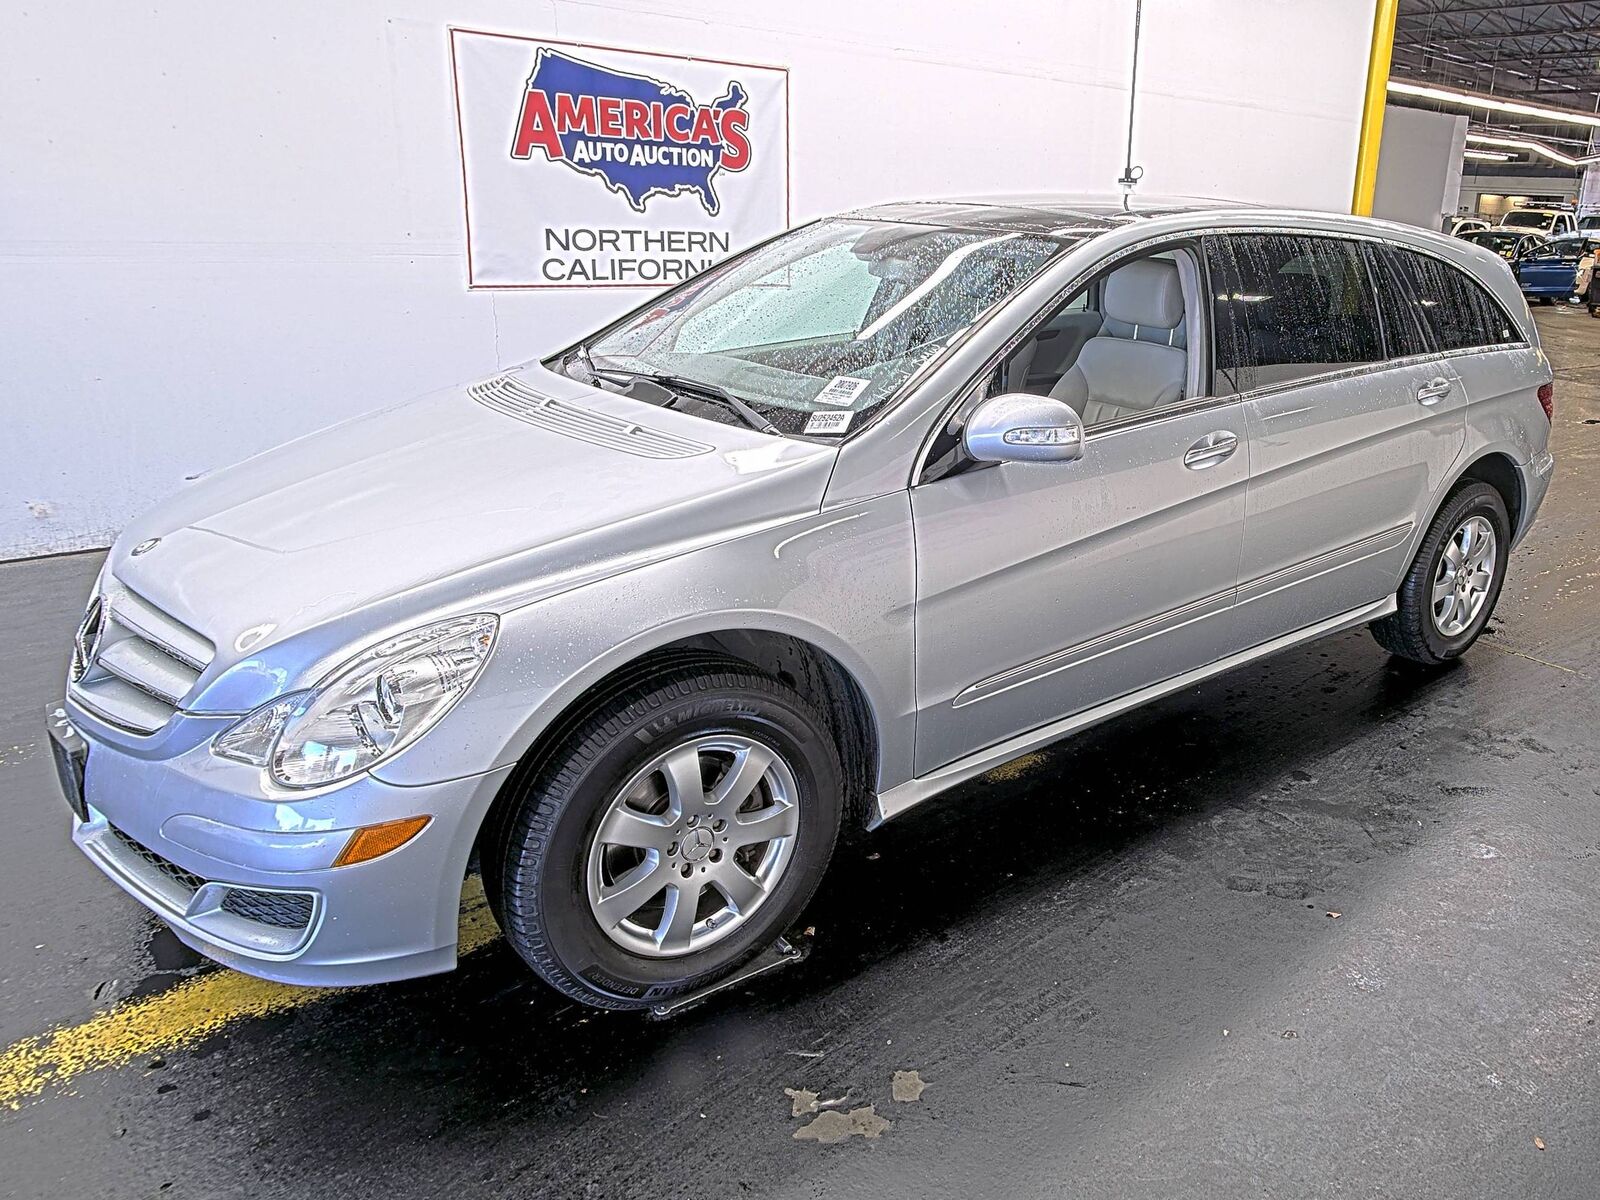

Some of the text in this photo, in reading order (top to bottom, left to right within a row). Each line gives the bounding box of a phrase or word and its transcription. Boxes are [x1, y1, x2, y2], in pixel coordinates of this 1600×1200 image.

[513, 89, 749, 171] AMERICA'S
[573, 140, 714, 168] AUTO AUCTION
[545, 228, 729, 253] NORTHERN
[592, 973, 639, 995] DEFENDER
